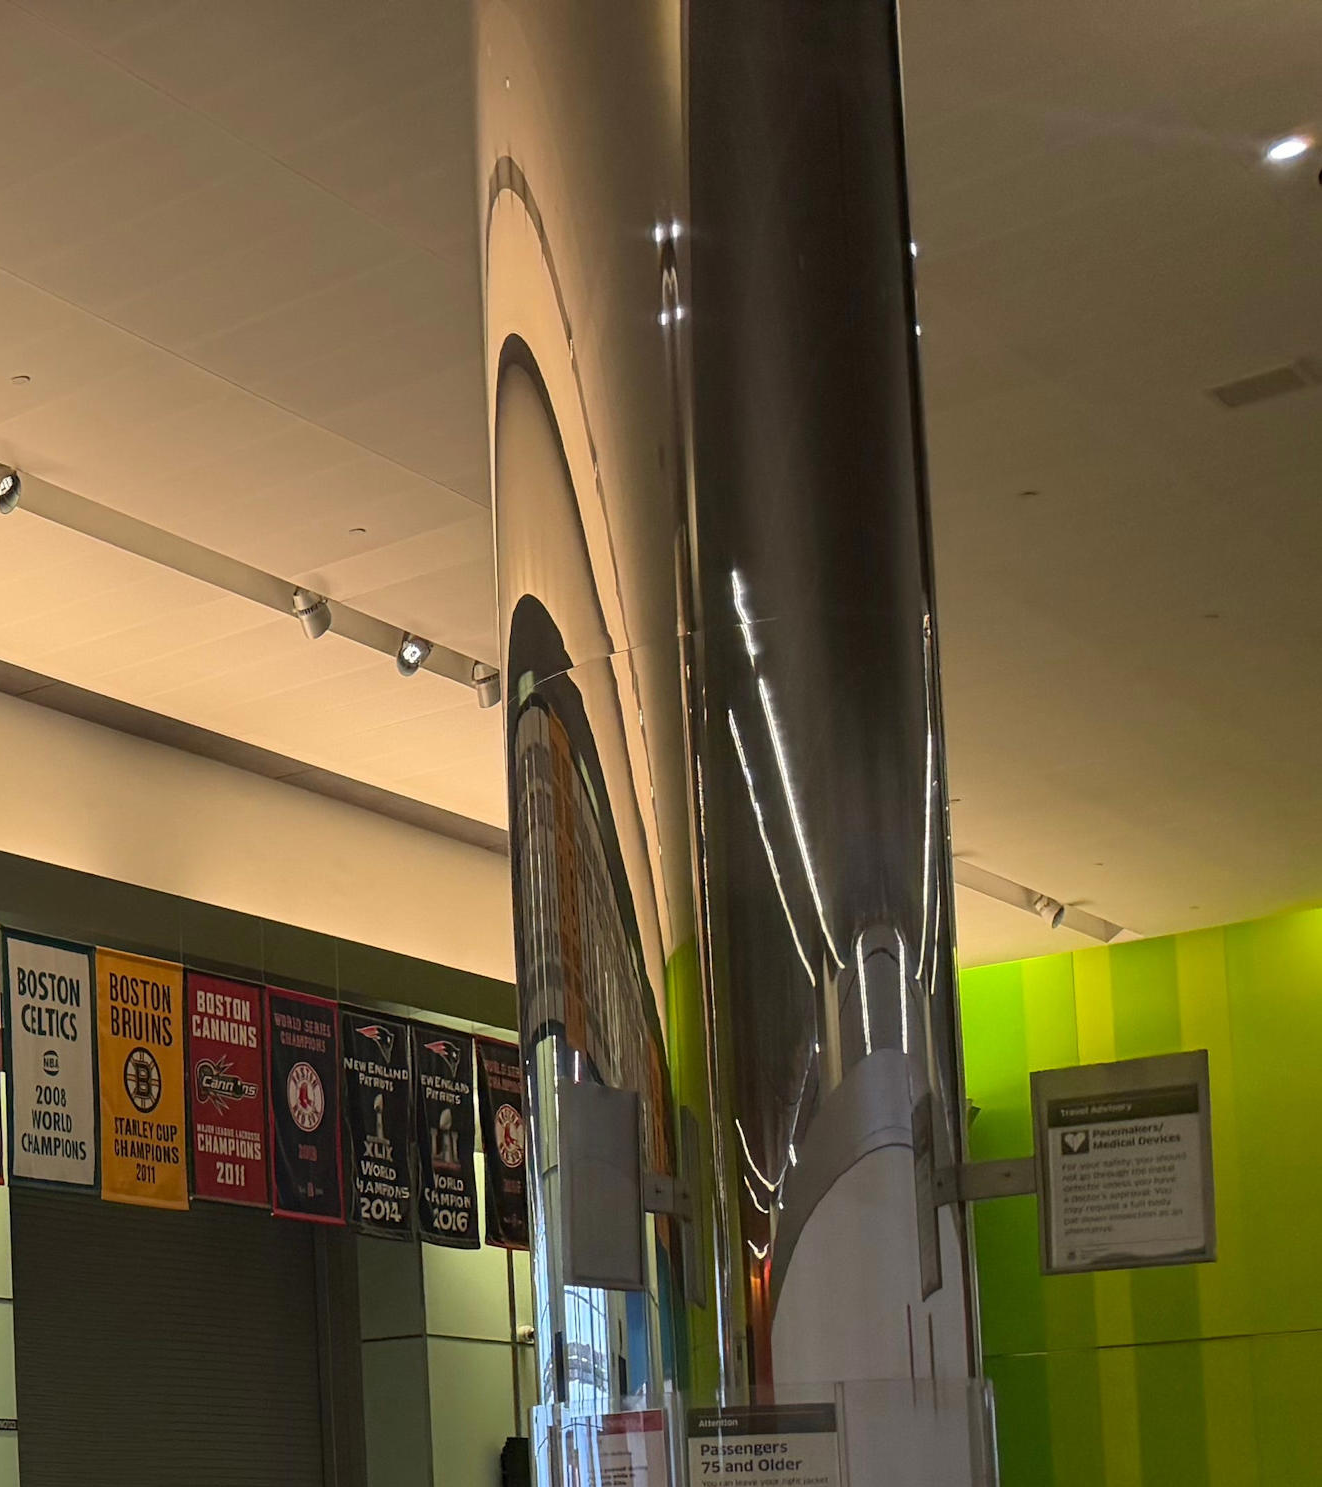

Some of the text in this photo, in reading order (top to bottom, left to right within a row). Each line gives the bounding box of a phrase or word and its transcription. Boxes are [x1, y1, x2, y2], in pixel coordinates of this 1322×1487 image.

[17, 967, 80, 1007] BOSTON
[110, 973, 172, 1014] BOSTON
[197, 990, 250, 1023] BOSTON
[21, 1004, 77, 1042] CELTICS
[111, 1005, 173, 1047] BRUINS
[192, 1014, 257, 1049] CANNONS
[344, 1057, 366, 1072] NEW
[36, 1085, 67, 1107] 2008
[32, 1110, 72, 1134] WORLD
[115, 1117, 177, 1143] STANLEY CUP
[22, 1133, 86, 1161] CHAMPIONS
[114, 1141, 179, 1164] CHAMPIONS
[197, 1133, 261, 1161] CHAMPIONS
[1092, 1134, 1181, 1150] Medical Devices
[136, 1163, 156, 1184] 2011
[216, 1162, 245, 1187] 2011
[360, 1197, 402, 1223] 2014
[699, 1419, 738, 1428] Attention
[701, 1443, 788, 1457] Passengers
[702, 1459, 802, 1474] 75 and Older
